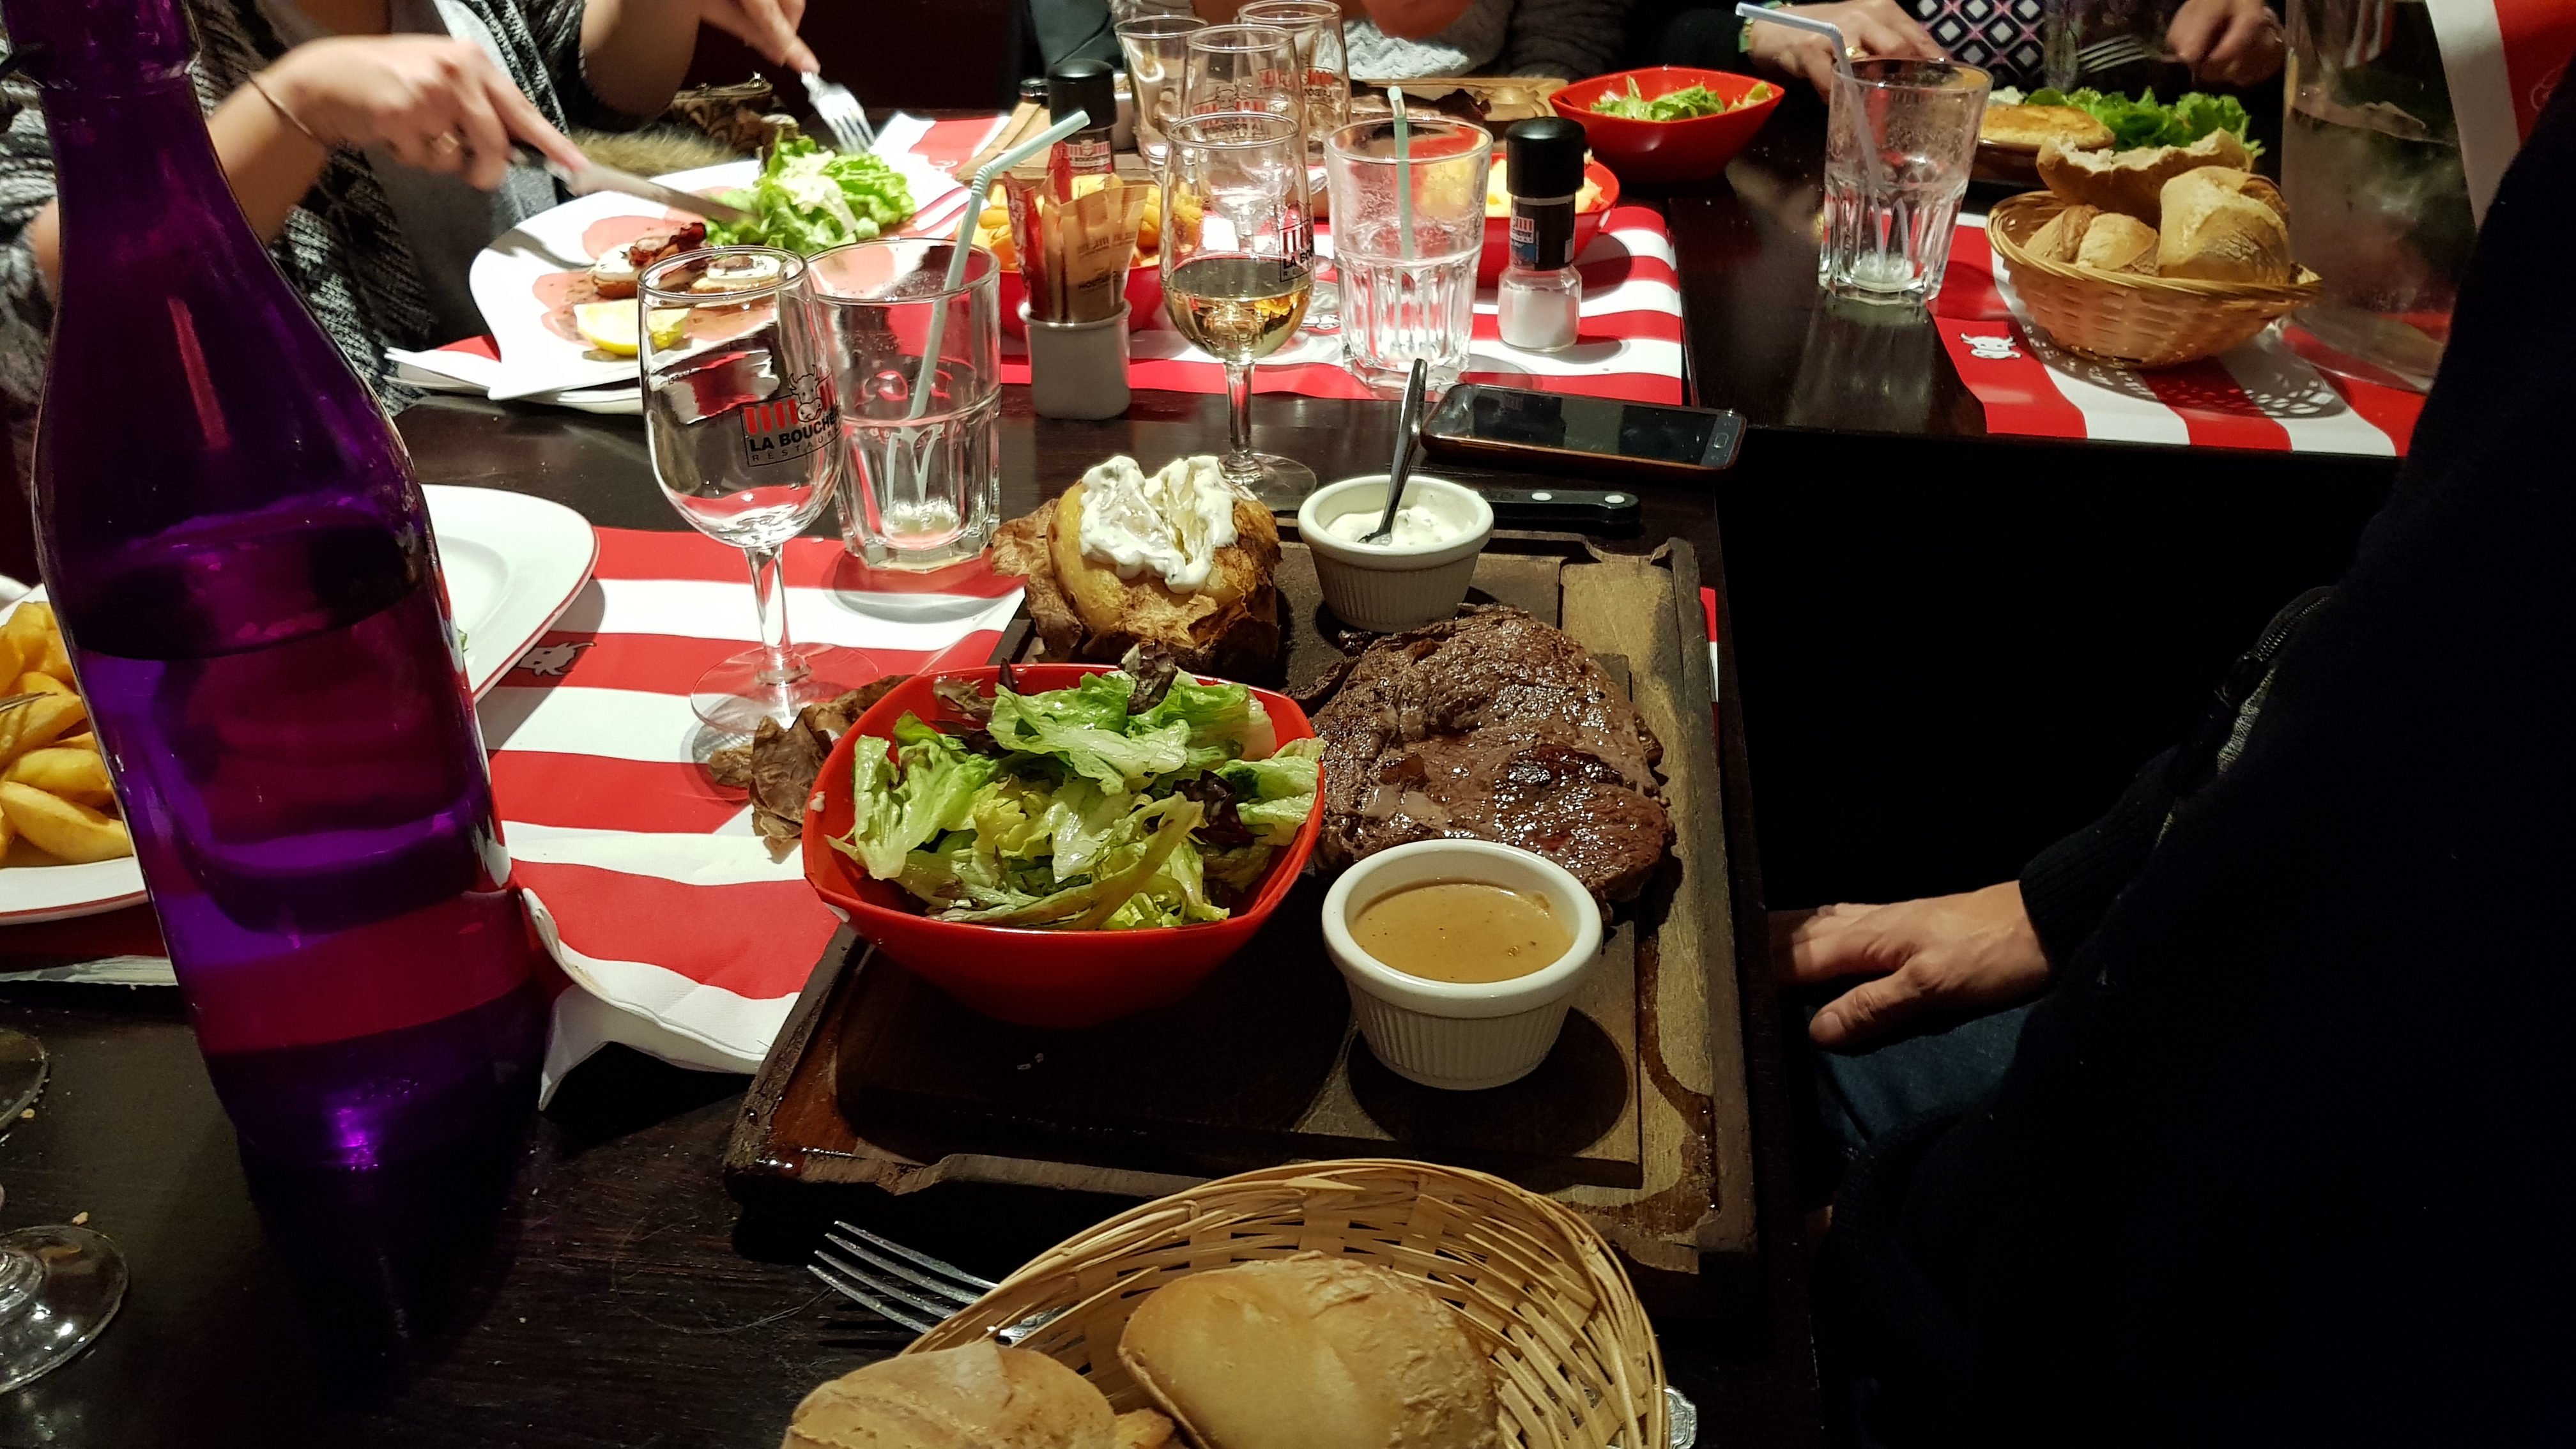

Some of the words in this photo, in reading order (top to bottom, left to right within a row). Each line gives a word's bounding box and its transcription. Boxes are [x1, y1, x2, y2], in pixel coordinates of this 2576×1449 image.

[1283, 256, 1297, 270] LA
[749, 436, 775, 452] LA
[778, 406, 839, 447] BOUCHE
[751, 430, 833, 463] RESTAUR
